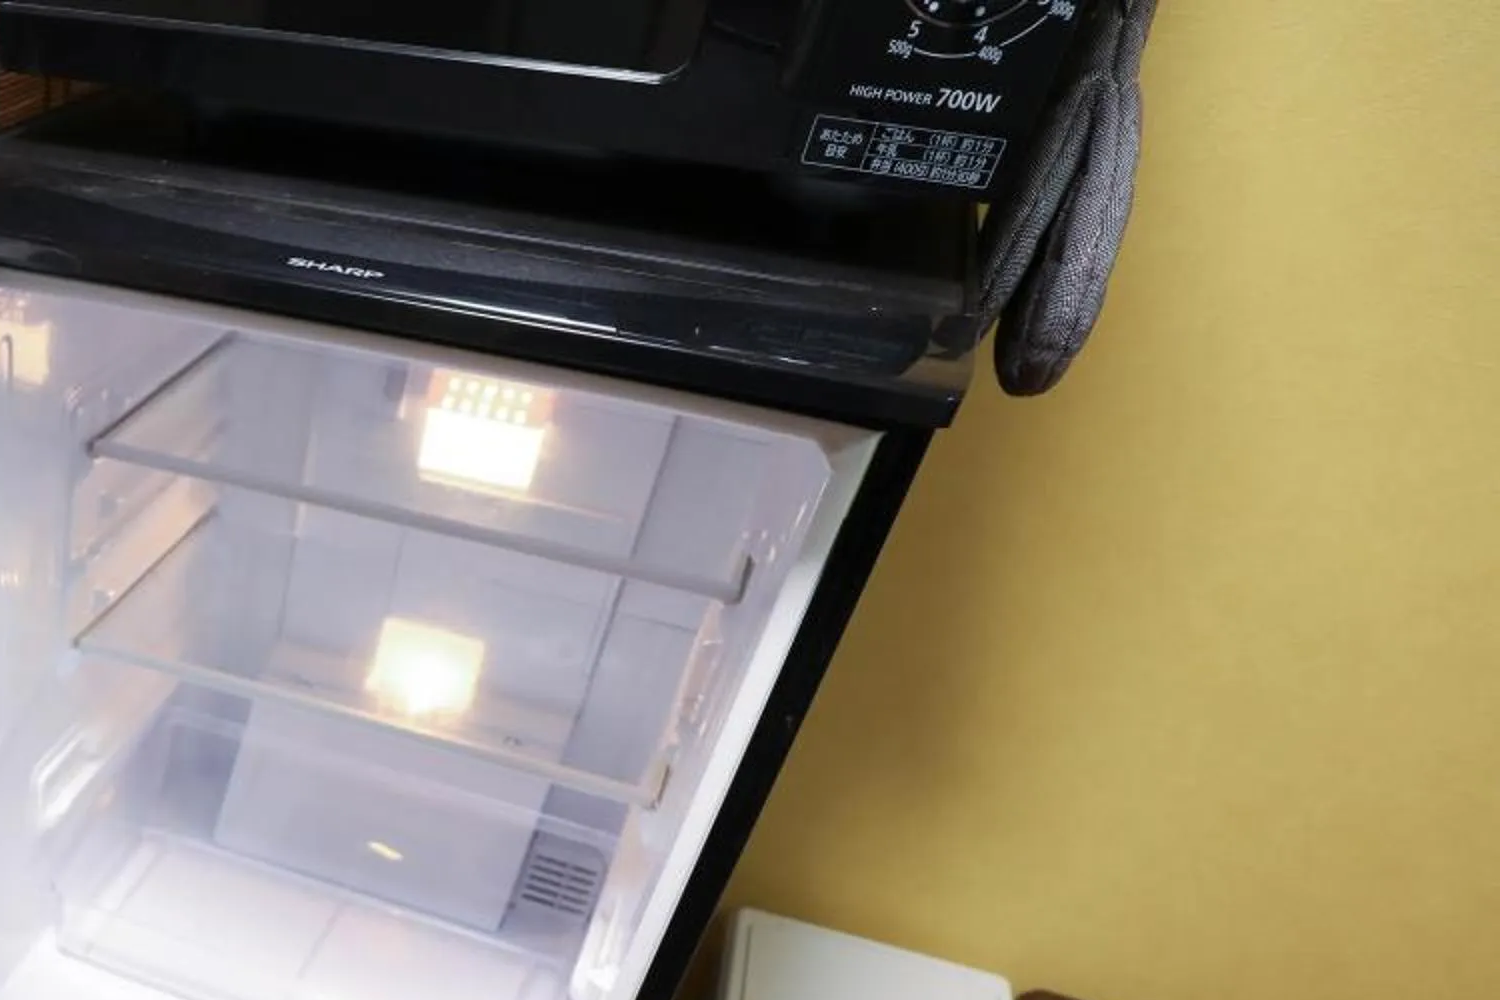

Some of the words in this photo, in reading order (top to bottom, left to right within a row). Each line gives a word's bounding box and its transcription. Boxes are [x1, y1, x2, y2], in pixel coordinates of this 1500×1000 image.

[907, 19, 923, 38] 5
[974, 26, 988, 43] 4
[849, 84, 883, 99] HIGH
[884, 88, 933, 106] POWER
[935, 87, 1002, 113] 700W
[286, 256, 386, 279] SHARP
